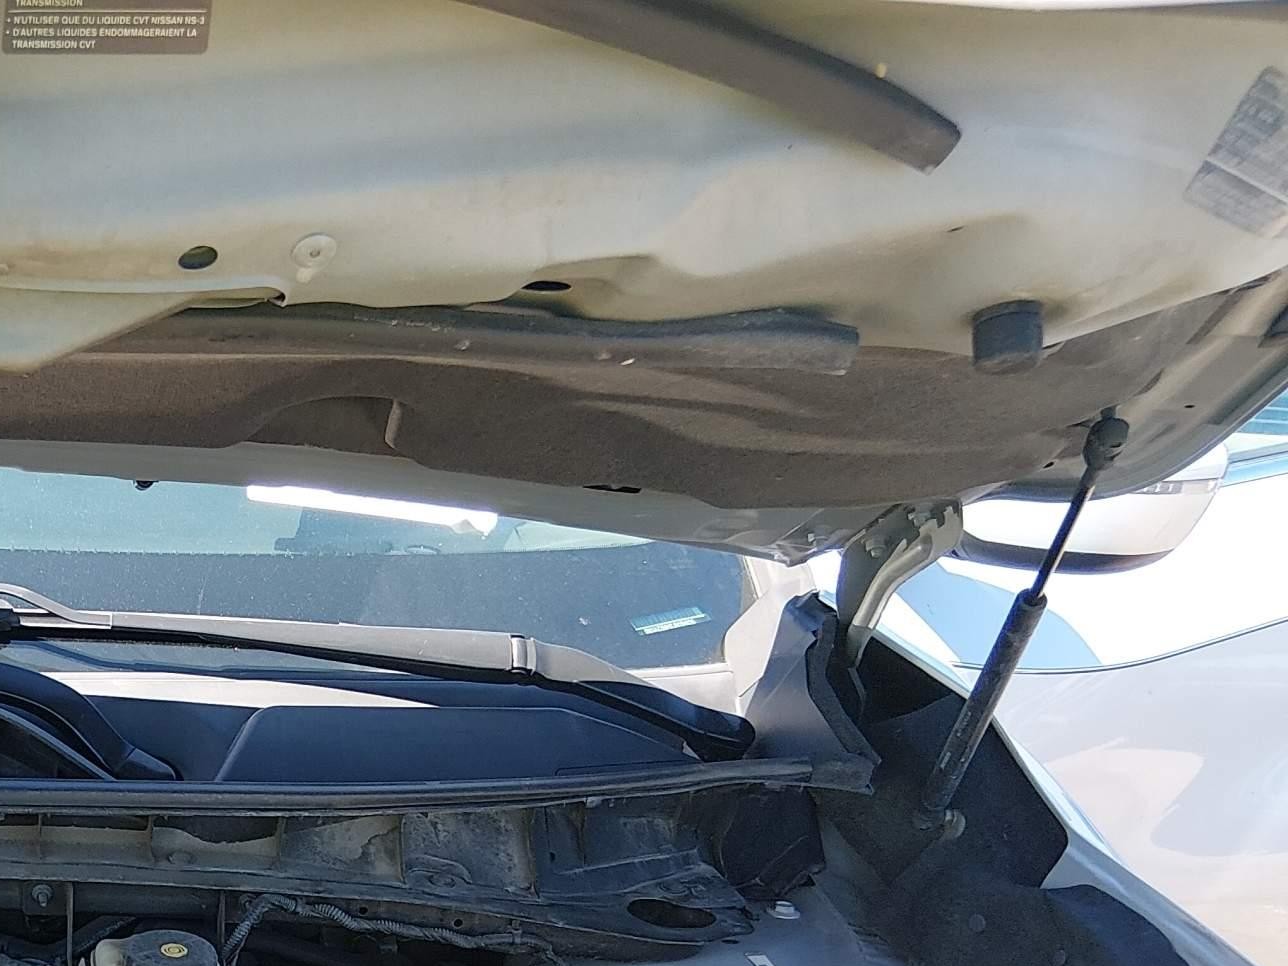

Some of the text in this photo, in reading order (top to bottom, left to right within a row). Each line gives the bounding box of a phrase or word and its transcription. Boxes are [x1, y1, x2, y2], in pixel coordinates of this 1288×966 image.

[14, 16, 59, 24] N'UTILISER
[62, 16, 80, 24] QUE
[97, 16, 130, 25] LIQUIDE
[133, 16, 150, 24] CVT
[152, 16, 183, 24] NISSAN
[13, 28, 196, 37] D'AUTRES LIQUIDES ENDOMMAGERAIENT LA
[12, 40, 96, 48] TRANSMISSION CVT
